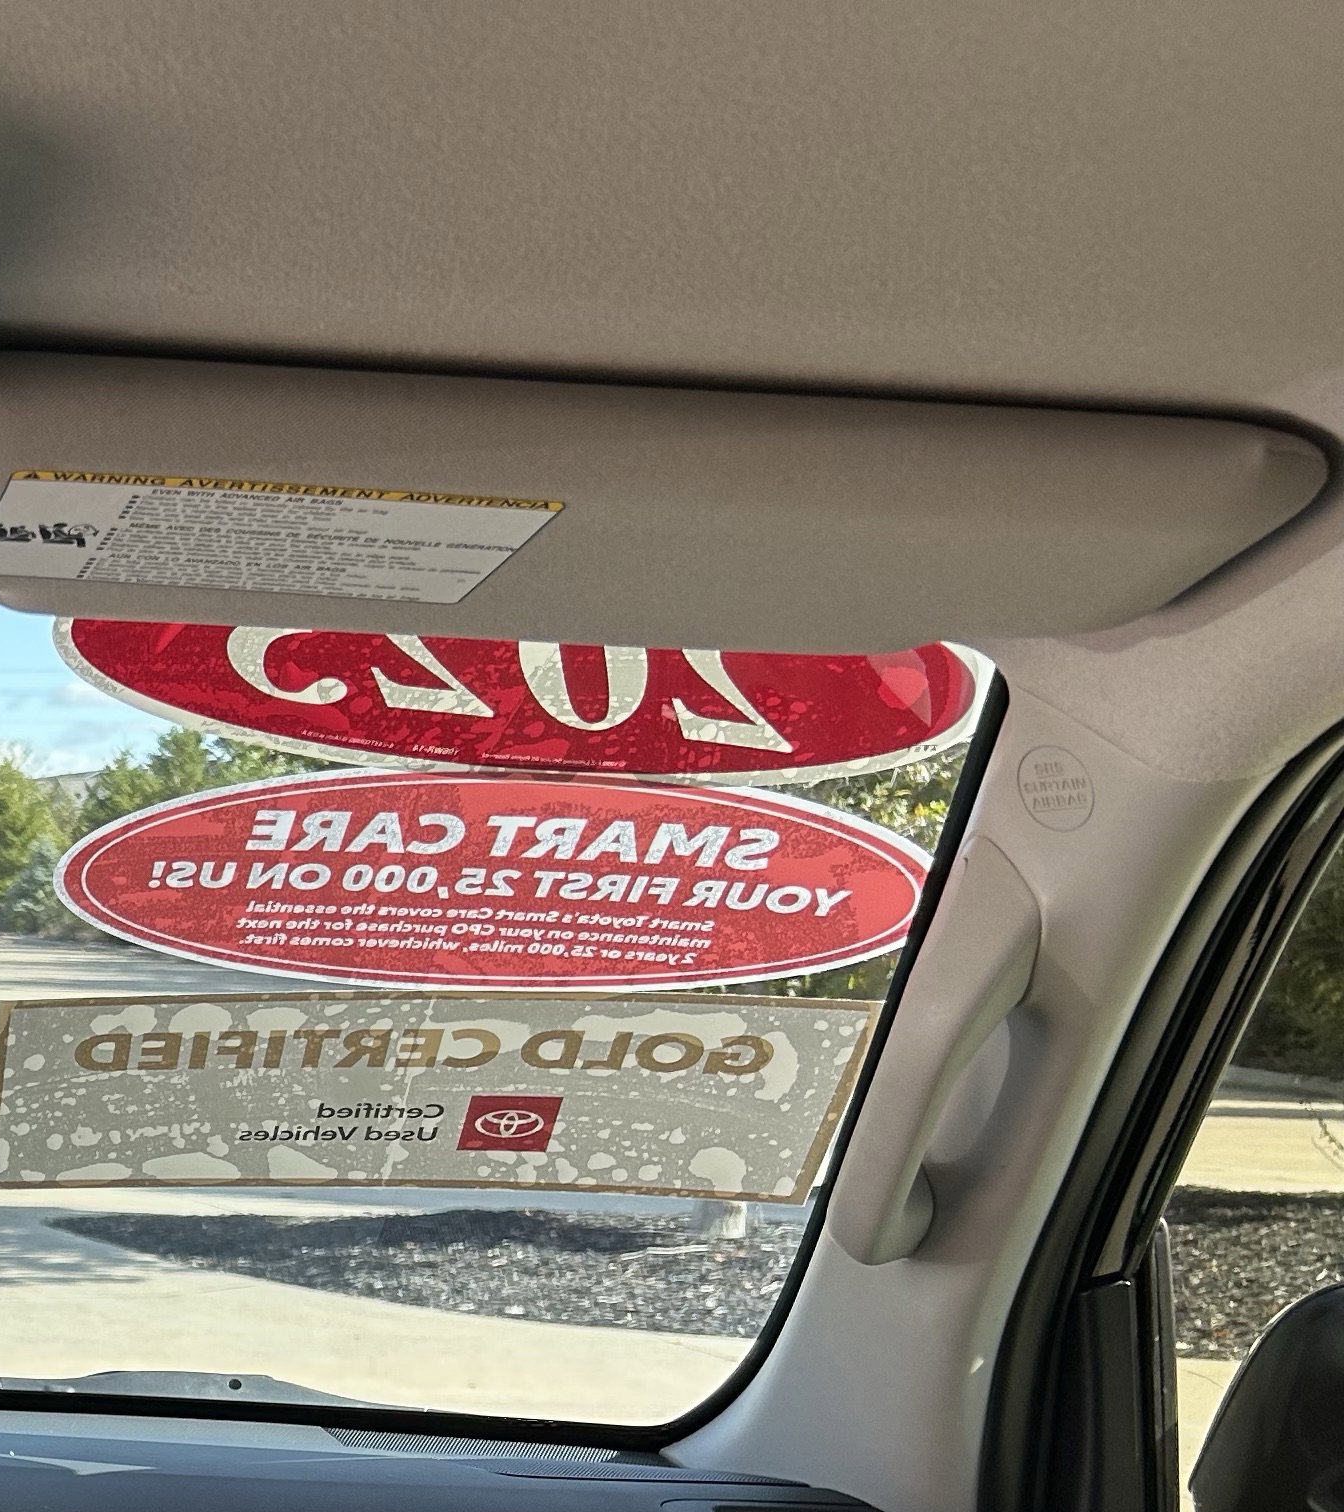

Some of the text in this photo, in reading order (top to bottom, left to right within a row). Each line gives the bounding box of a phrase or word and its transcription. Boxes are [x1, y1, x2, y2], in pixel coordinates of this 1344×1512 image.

[53, 472, 550, 510] WARNING AVERTISSEMENT ADVERTENCIA
[187, 490, 215, 498] WITH
